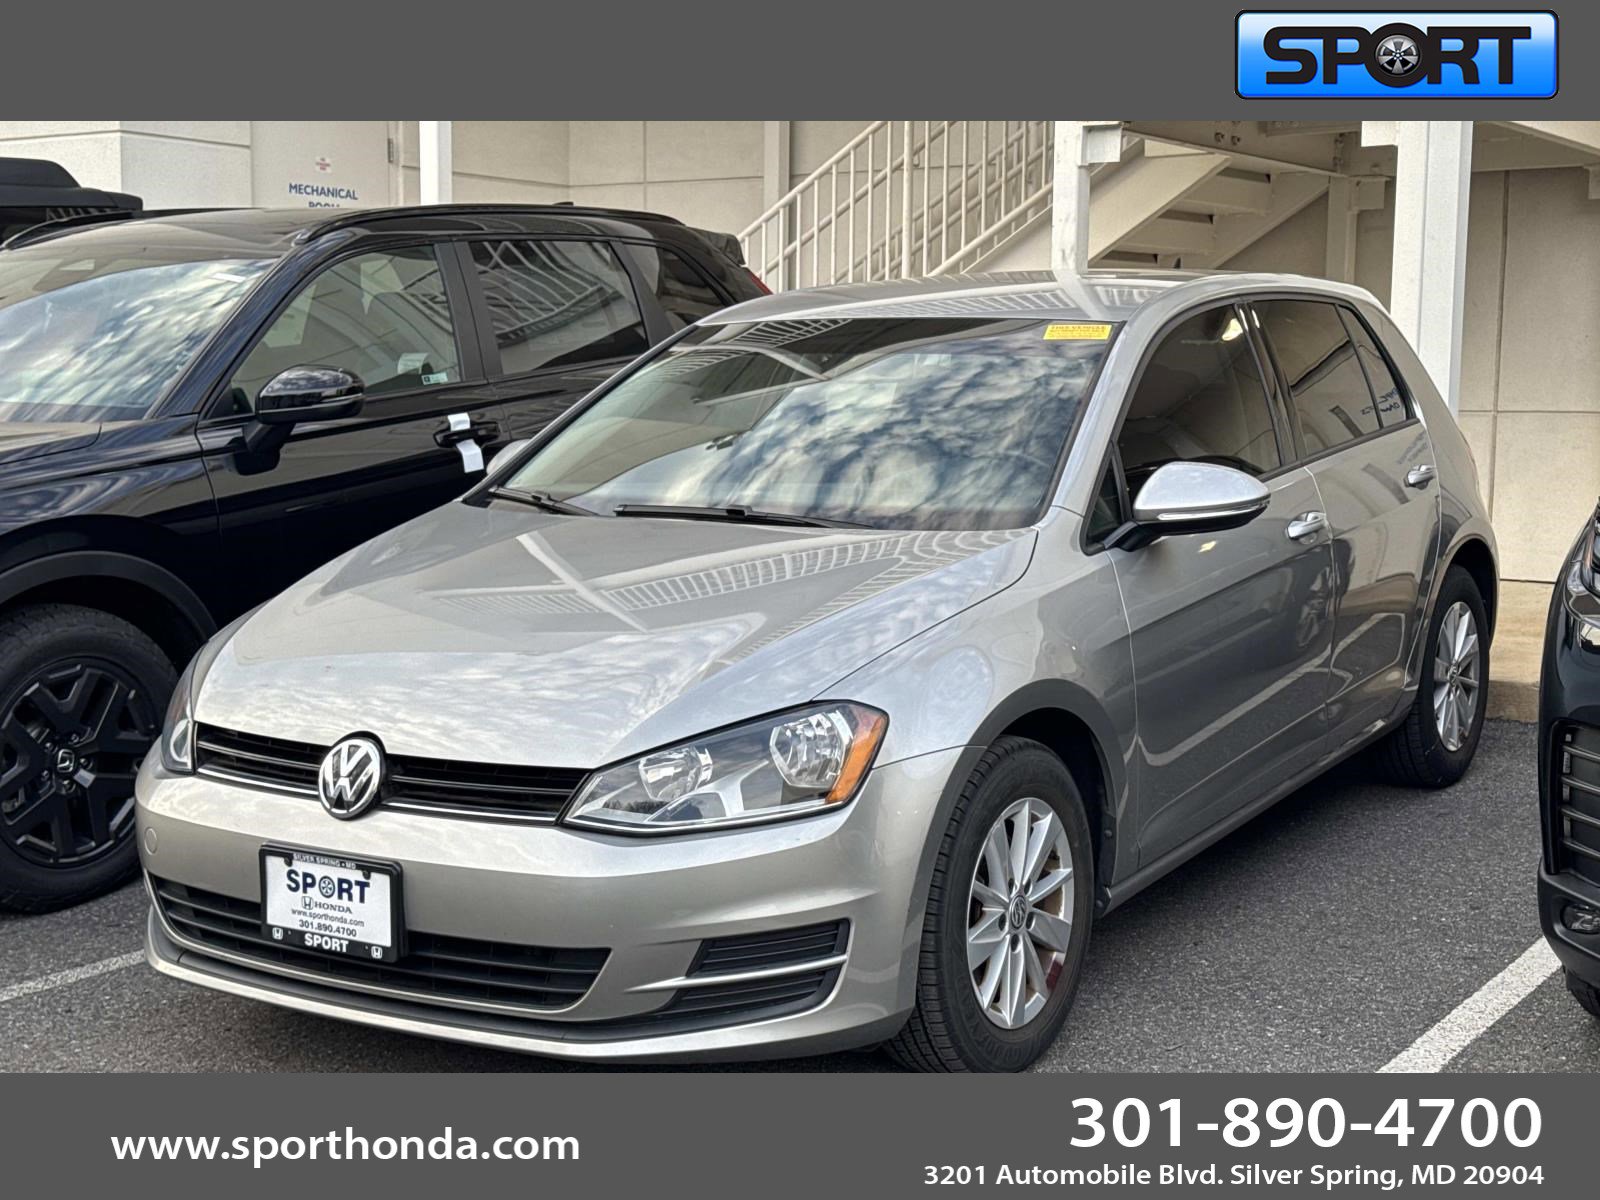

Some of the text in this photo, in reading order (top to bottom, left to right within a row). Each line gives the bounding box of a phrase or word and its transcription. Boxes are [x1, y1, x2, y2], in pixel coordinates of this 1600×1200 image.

[288, 182, 359, 201] MECHANICAL
[293, 853, 315, 864] SILVER
[316, 857, 340, 868] SPRING
[286, 868, 371, 904] SPORT
[314, 900, 353, 914] HONDA
[291, 908, 365, 927] www.sporthonda.com
[299, 919, 357, 937] 301.890.4700
[304, 932, 349, 953] SPORT
